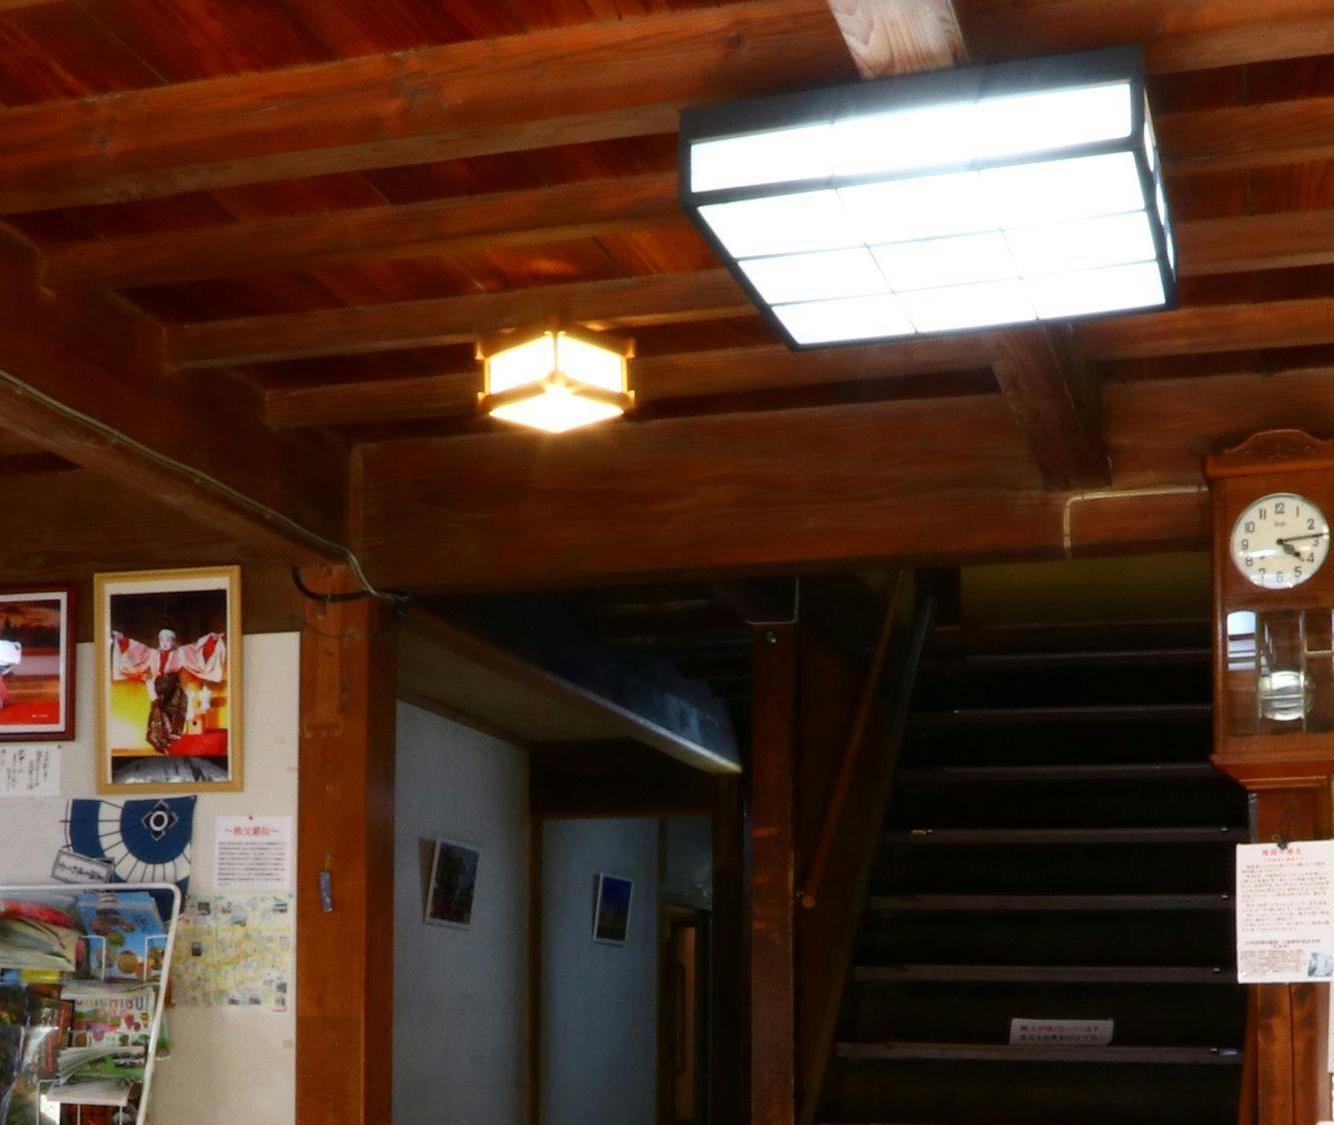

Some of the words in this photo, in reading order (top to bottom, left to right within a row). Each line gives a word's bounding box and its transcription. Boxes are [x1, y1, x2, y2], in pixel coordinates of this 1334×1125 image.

[1259, 508, 1267, 520] 11
[1275, 502, 1285, 515] 12
[1295, 506, 1300, 517] 1
[1245, 521, 1256, 533] 10
[1307, 518, 1315, 530] 2
[1241, 538, 1249, 551] 9
[1245, 555, 1253, 567] 8
[1306, 552, 1315, 563] 4
[1276, 571, 1284, 583] 6
[1294, 566, 1302, 578] 5
